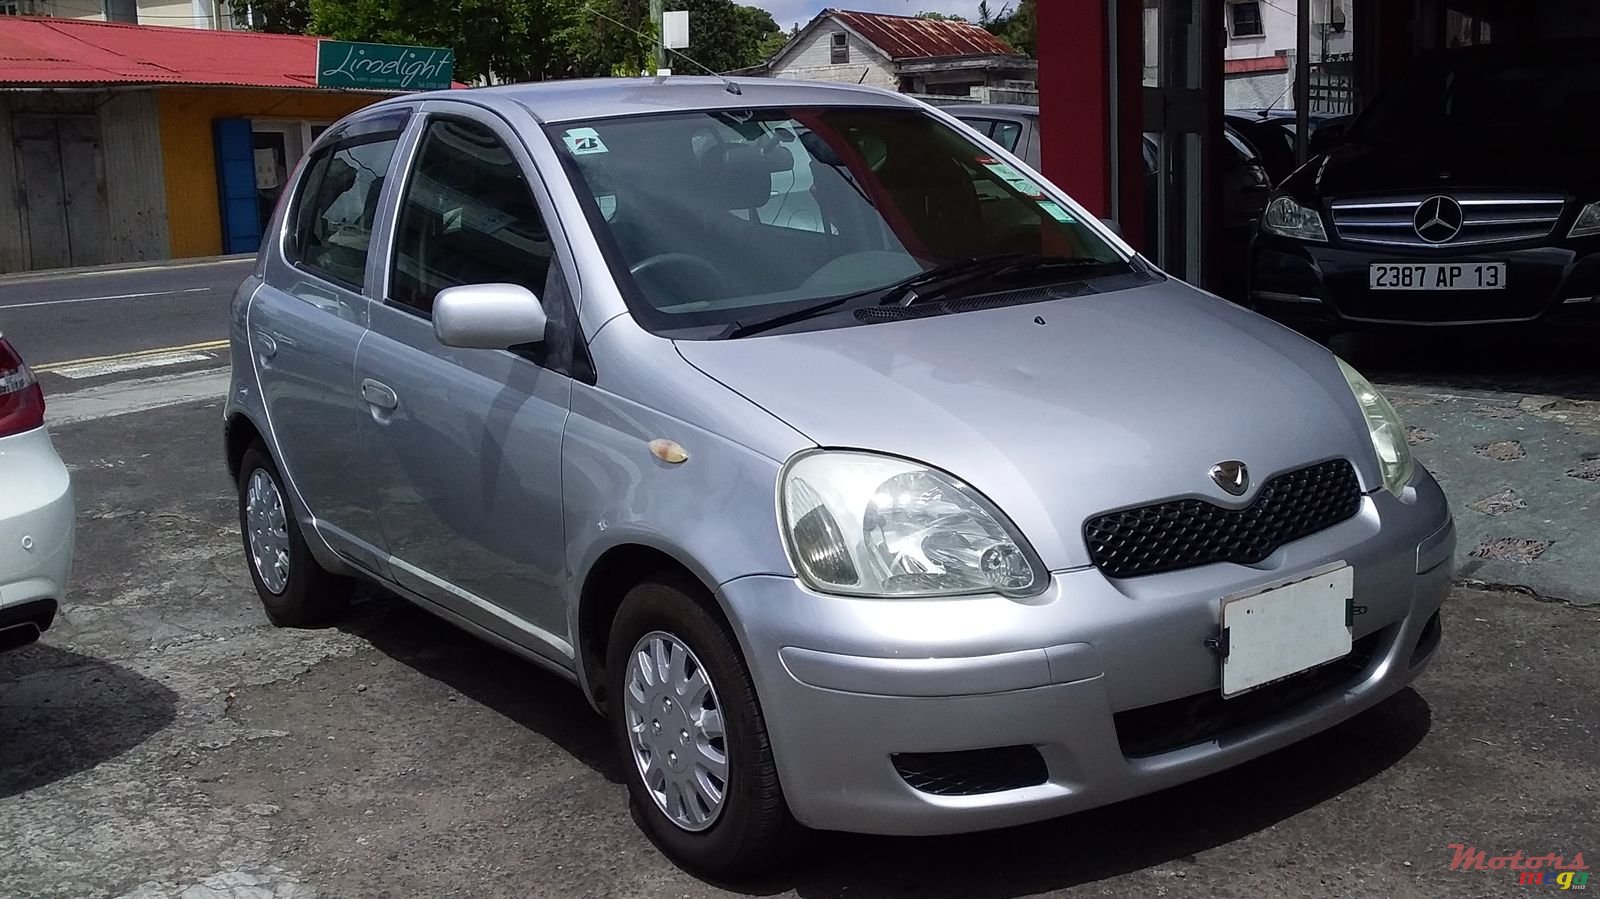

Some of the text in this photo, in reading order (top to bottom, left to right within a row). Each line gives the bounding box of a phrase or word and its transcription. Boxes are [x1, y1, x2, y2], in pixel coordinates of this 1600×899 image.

[322, 45, 451, 88] Limelight
[1376, 265, 1499, 287] 2387 AP 13
